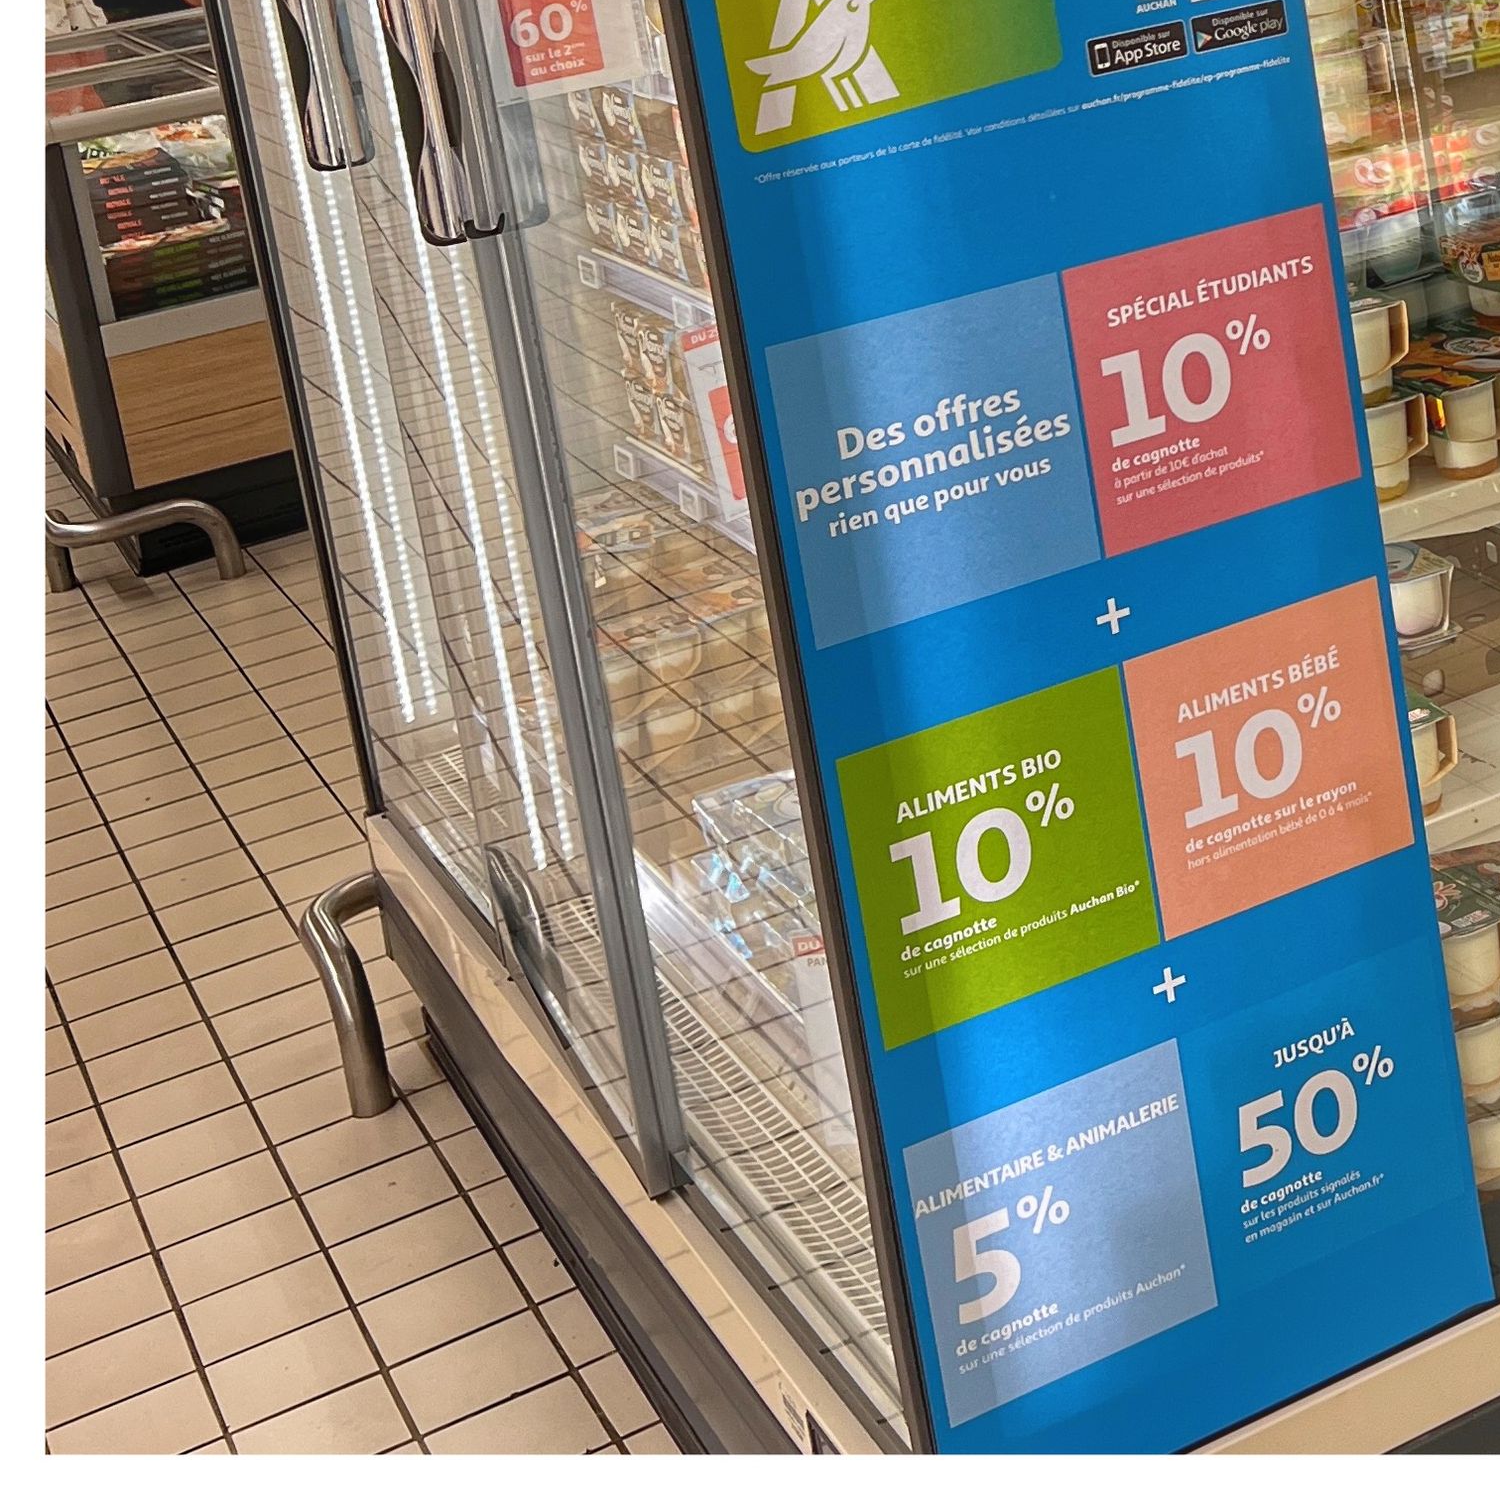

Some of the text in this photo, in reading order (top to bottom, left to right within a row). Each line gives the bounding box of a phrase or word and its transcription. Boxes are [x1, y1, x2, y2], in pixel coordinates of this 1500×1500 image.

[1114, 37, 1181, 65] App Store
[1215, 16, 1283, 41] Google play
[531, 57, 585, 76] au choix
[1107, 255, 1314, 328] SPÉCIAL ÉTUDIANTS
[837, 389, 1020, 460] Des offres
[1112, 437, 1201, 472] de cagnotte
[796, 413, 1071, 522] personnalisées
[829, 458, 1051, 538] rien que pour vous
[1177, 645, 1340, 723] ALIMENTS BÉBÉ
[897, 749, 1061, 824] ALIMENTS BIO
[1186, 781, 1357, 853] de cagnotte sur le rayon
[901, 917, 997, 962] de cagnotte
[904, 964, 923, 979] sur
[925, 955, 947, 971] une
[950, 935, 1001, 962] sélection
[1004, 928, 1018, 941] de
[1020, 908, 1067, 937] produits
[1070, 892, 1114, 915] Auchan
[1273, 1017, 1355, 1068] JUSQU'À
[915, 1094, 1179, 1219] ALIMENTAIRE & ANIMALERIE
[1241, 1171, 1322, 1214] de cagnotte
[956, 1303, 1059, 1357] de cagnotte
